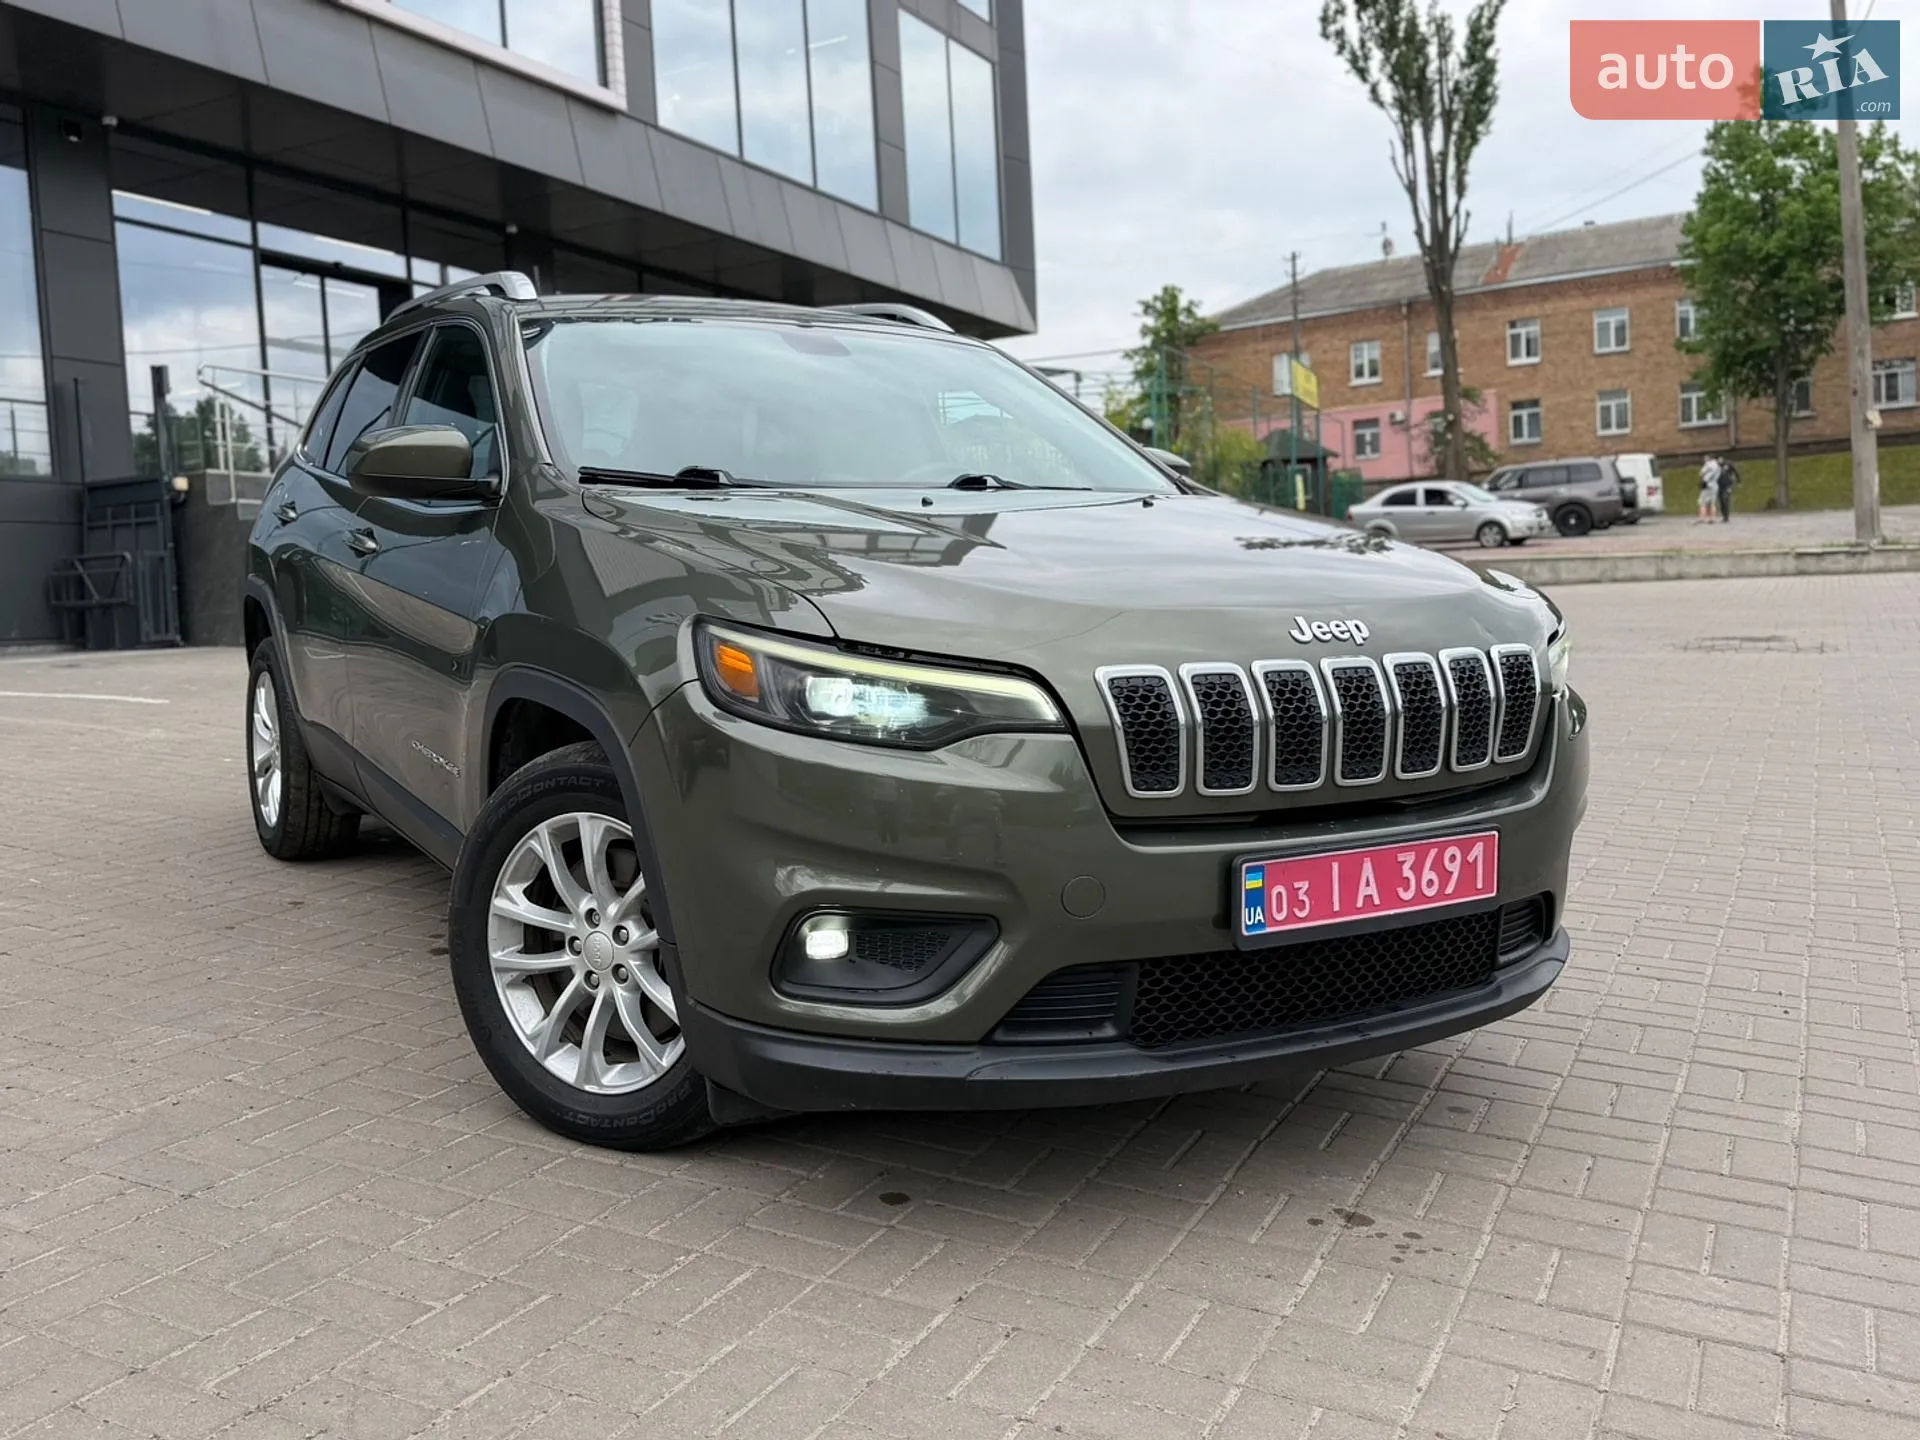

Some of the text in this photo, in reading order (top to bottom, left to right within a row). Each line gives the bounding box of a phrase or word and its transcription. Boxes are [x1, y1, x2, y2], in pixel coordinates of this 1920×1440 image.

[1289, 616, 1370, 645] Jeep
[1270, 841, 1485, 921] 03 IA 3691
[1245, 907, 1265, 925] UA
